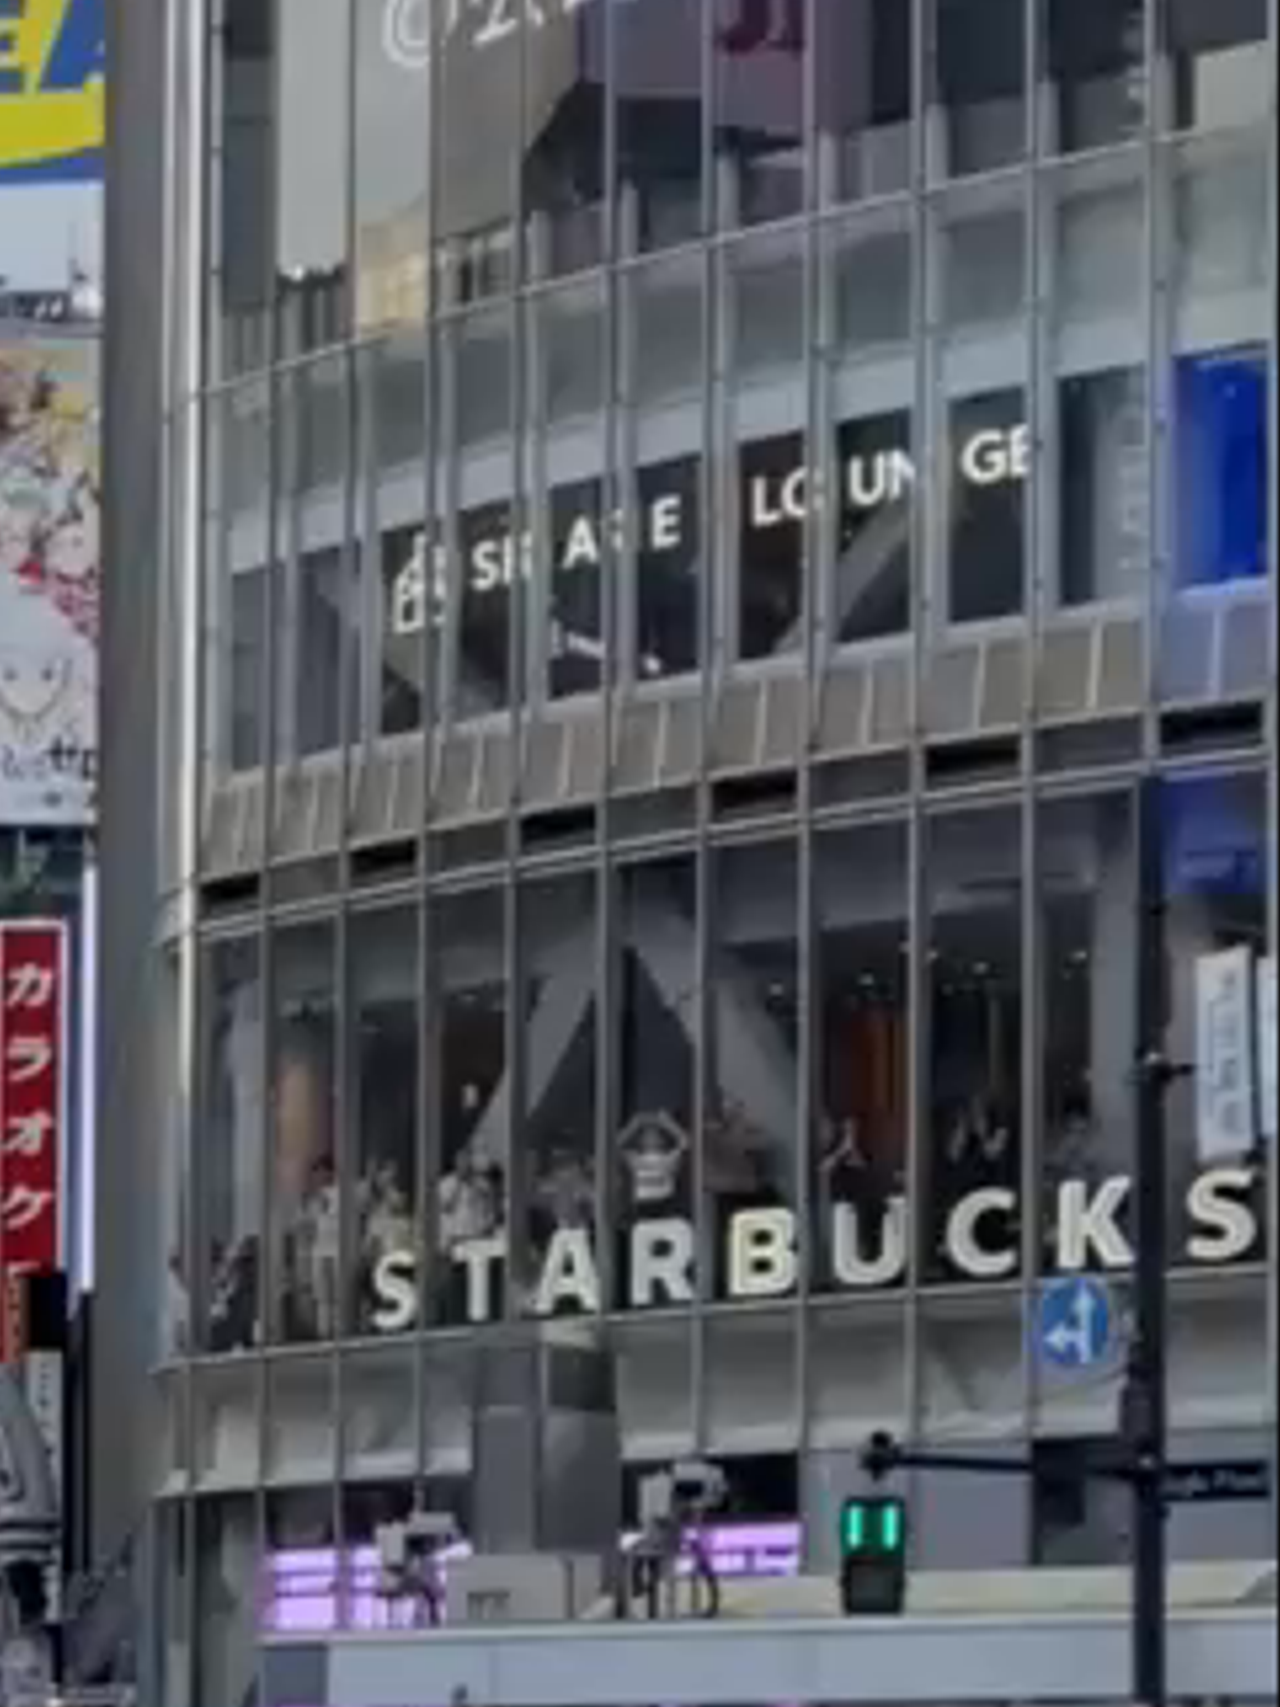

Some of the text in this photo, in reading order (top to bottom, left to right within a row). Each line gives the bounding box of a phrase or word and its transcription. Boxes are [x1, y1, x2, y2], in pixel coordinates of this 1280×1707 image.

[2, 962, 54, 1277] カラオケ
[370, 1165, 1257, 1332] STARBUCKS
